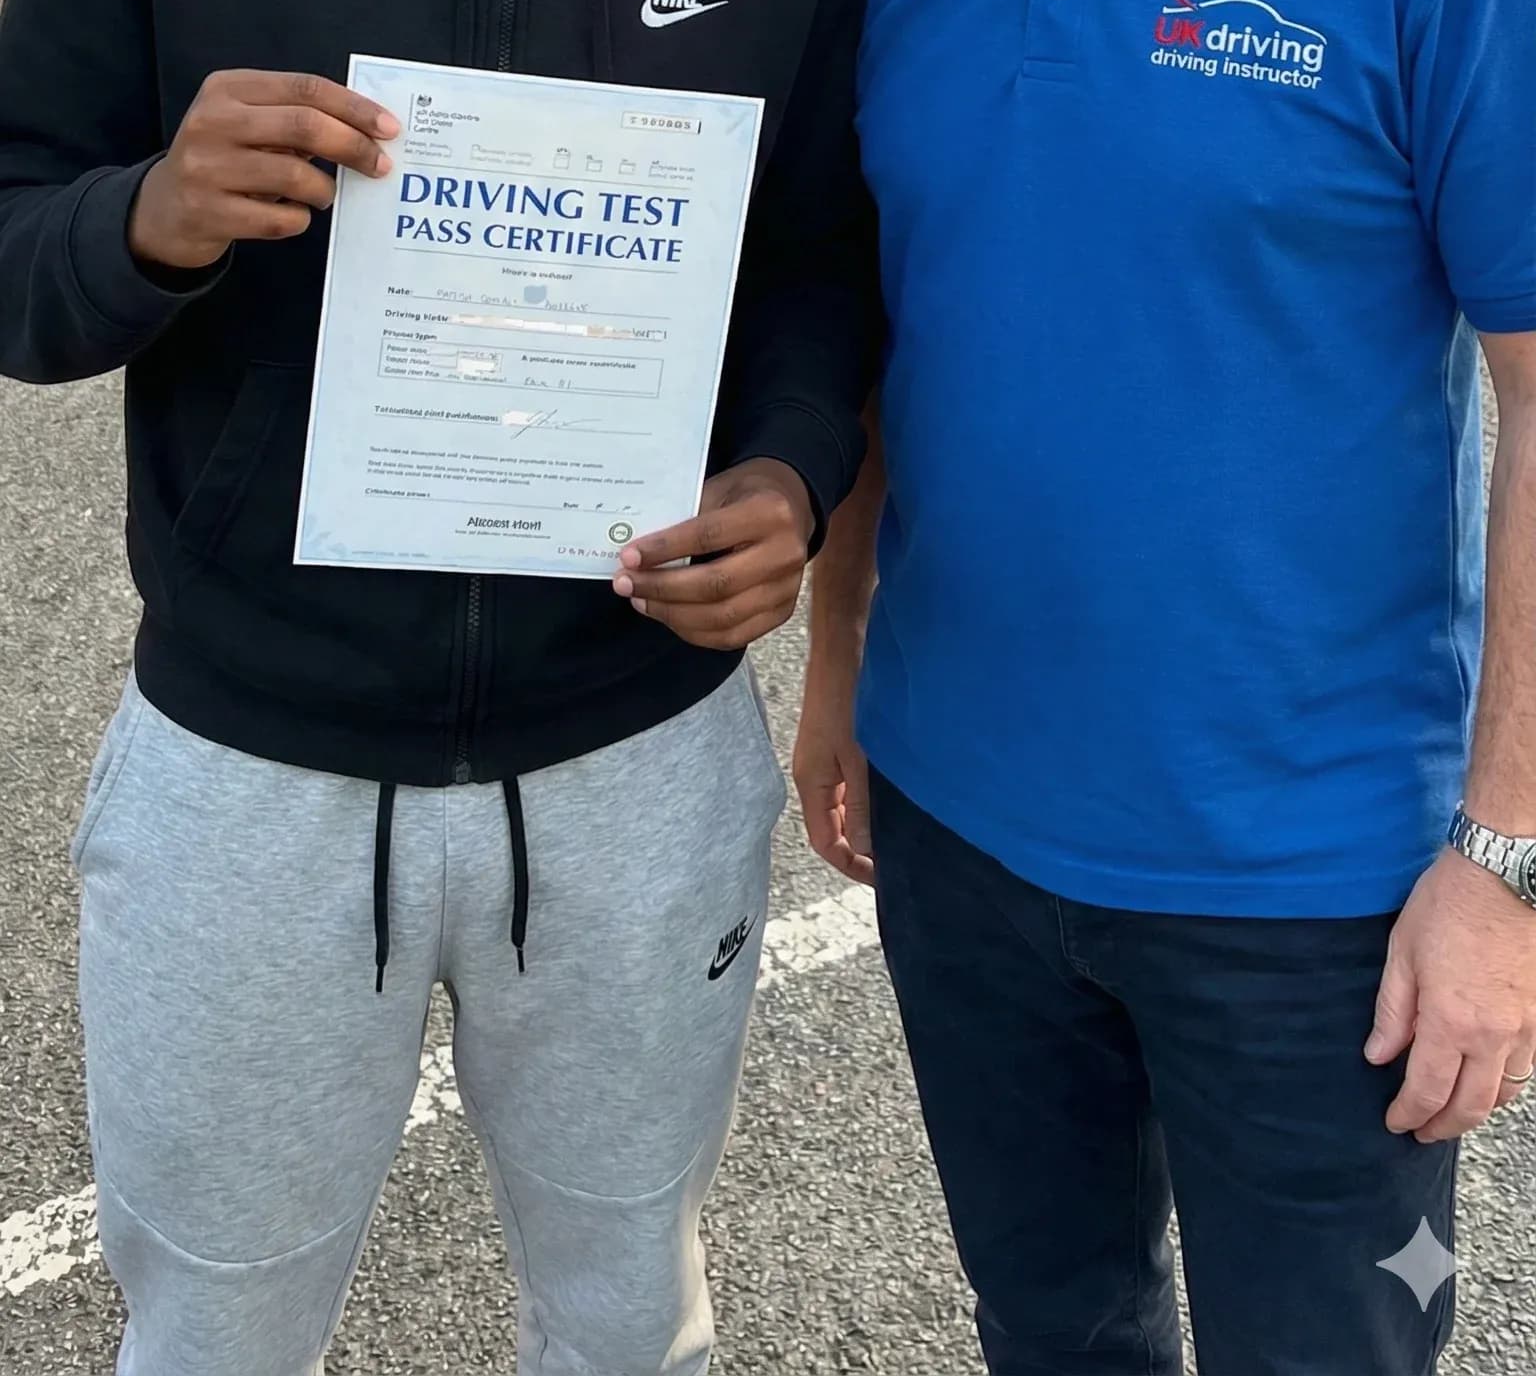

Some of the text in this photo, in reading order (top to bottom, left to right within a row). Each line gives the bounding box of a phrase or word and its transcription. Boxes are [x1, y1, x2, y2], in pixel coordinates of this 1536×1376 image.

[1150, 48, 1322, 90] driving instructor
[1154, 16, 1324, 73] UK driving
[400, 173, 690, 227] DRIVING TEST
[396, 214, 684, 263] PASS CERTIFICATE
[716, 915, 748, 963] NIKE
